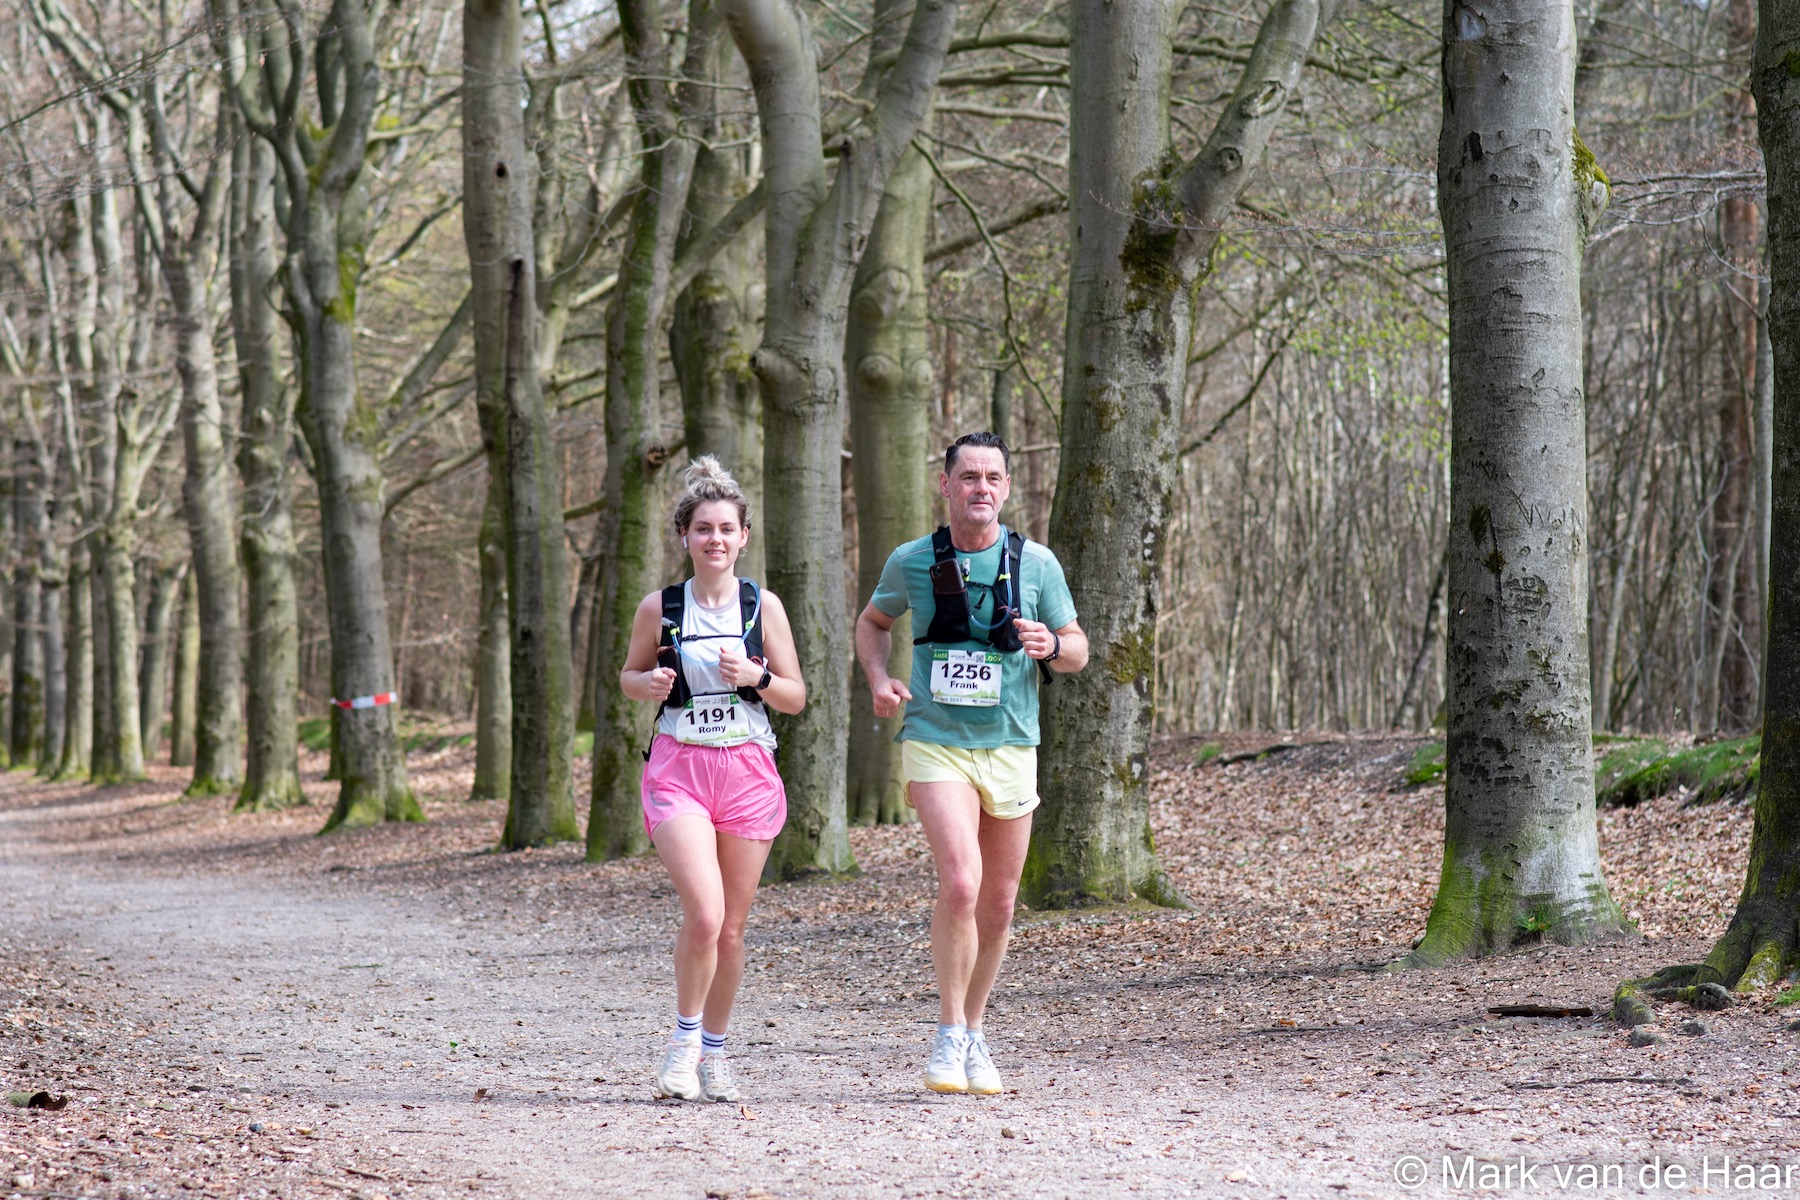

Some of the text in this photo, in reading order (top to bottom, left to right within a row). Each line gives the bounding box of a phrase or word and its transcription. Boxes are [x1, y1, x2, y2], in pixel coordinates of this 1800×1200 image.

[941, 663, 991, 681] 1256
[950, 680, 978, 690] Frank
[685, 706, 736, 725] 1191
[698, 725, 727, 734] Romy
